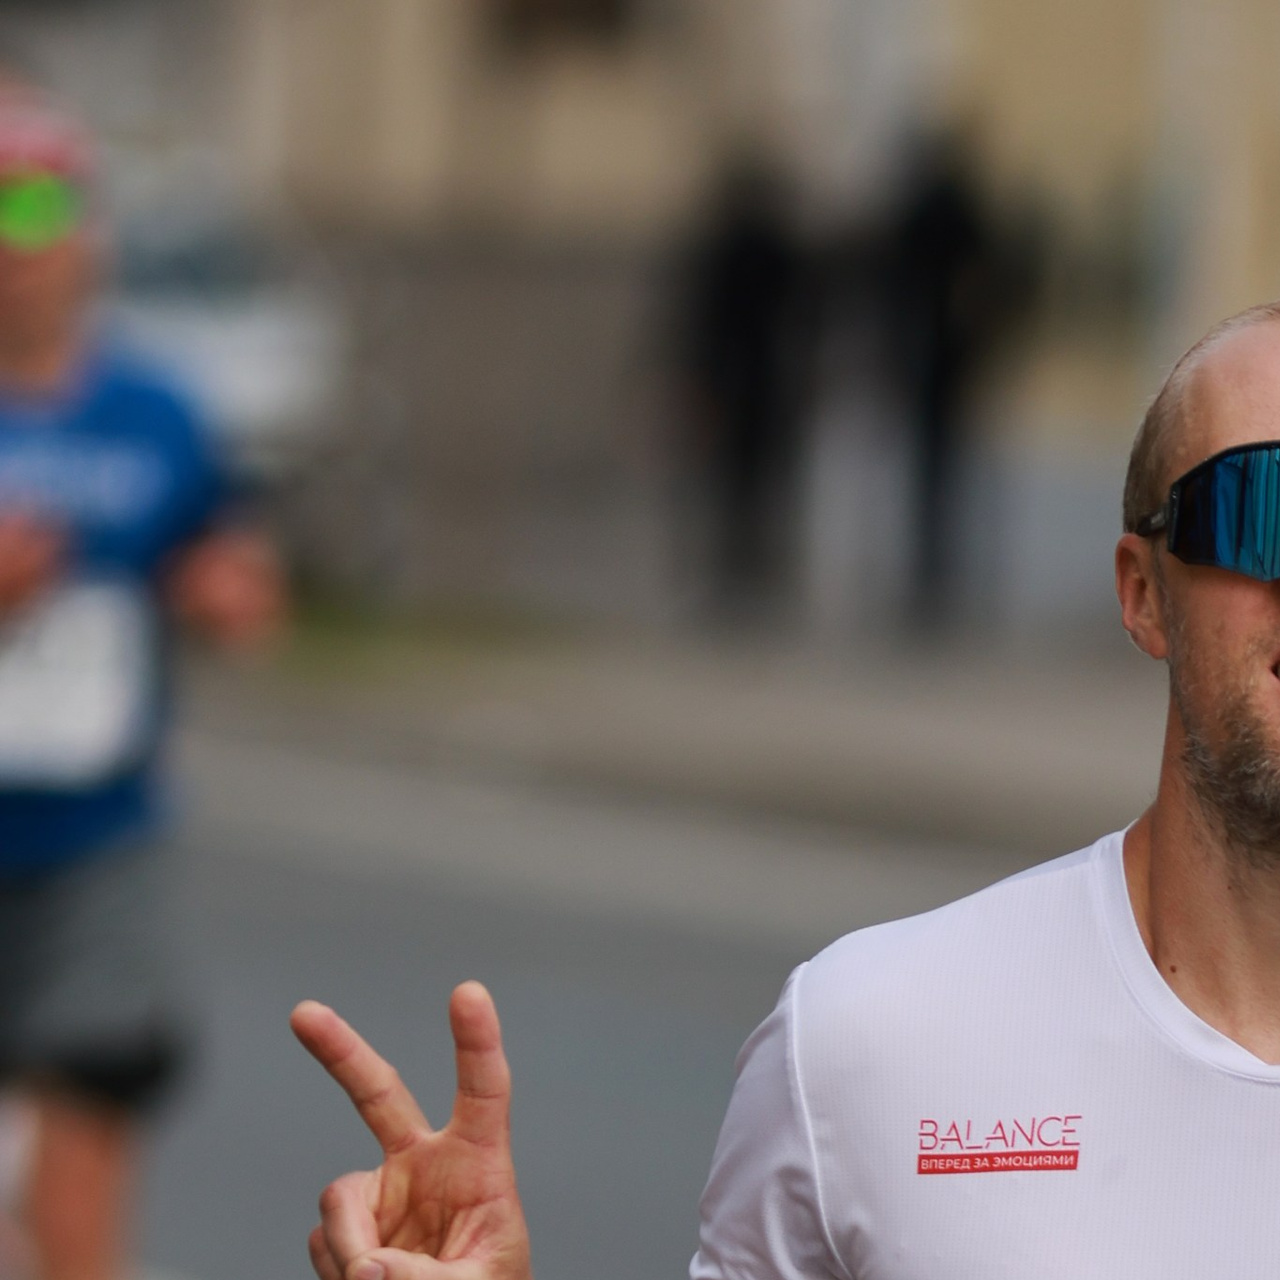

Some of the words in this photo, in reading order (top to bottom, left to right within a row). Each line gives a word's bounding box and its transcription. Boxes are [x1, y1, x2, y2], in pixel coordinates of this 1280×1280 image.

[918, 1115, 1082, 1150] BALANCE
[920, 1157, 970, 1170] ВПЕРЕД
[973, 1156, 989, 1168] ЗА
[992, 1154, 1074, 1168] ЭМОЦИЯМИ
